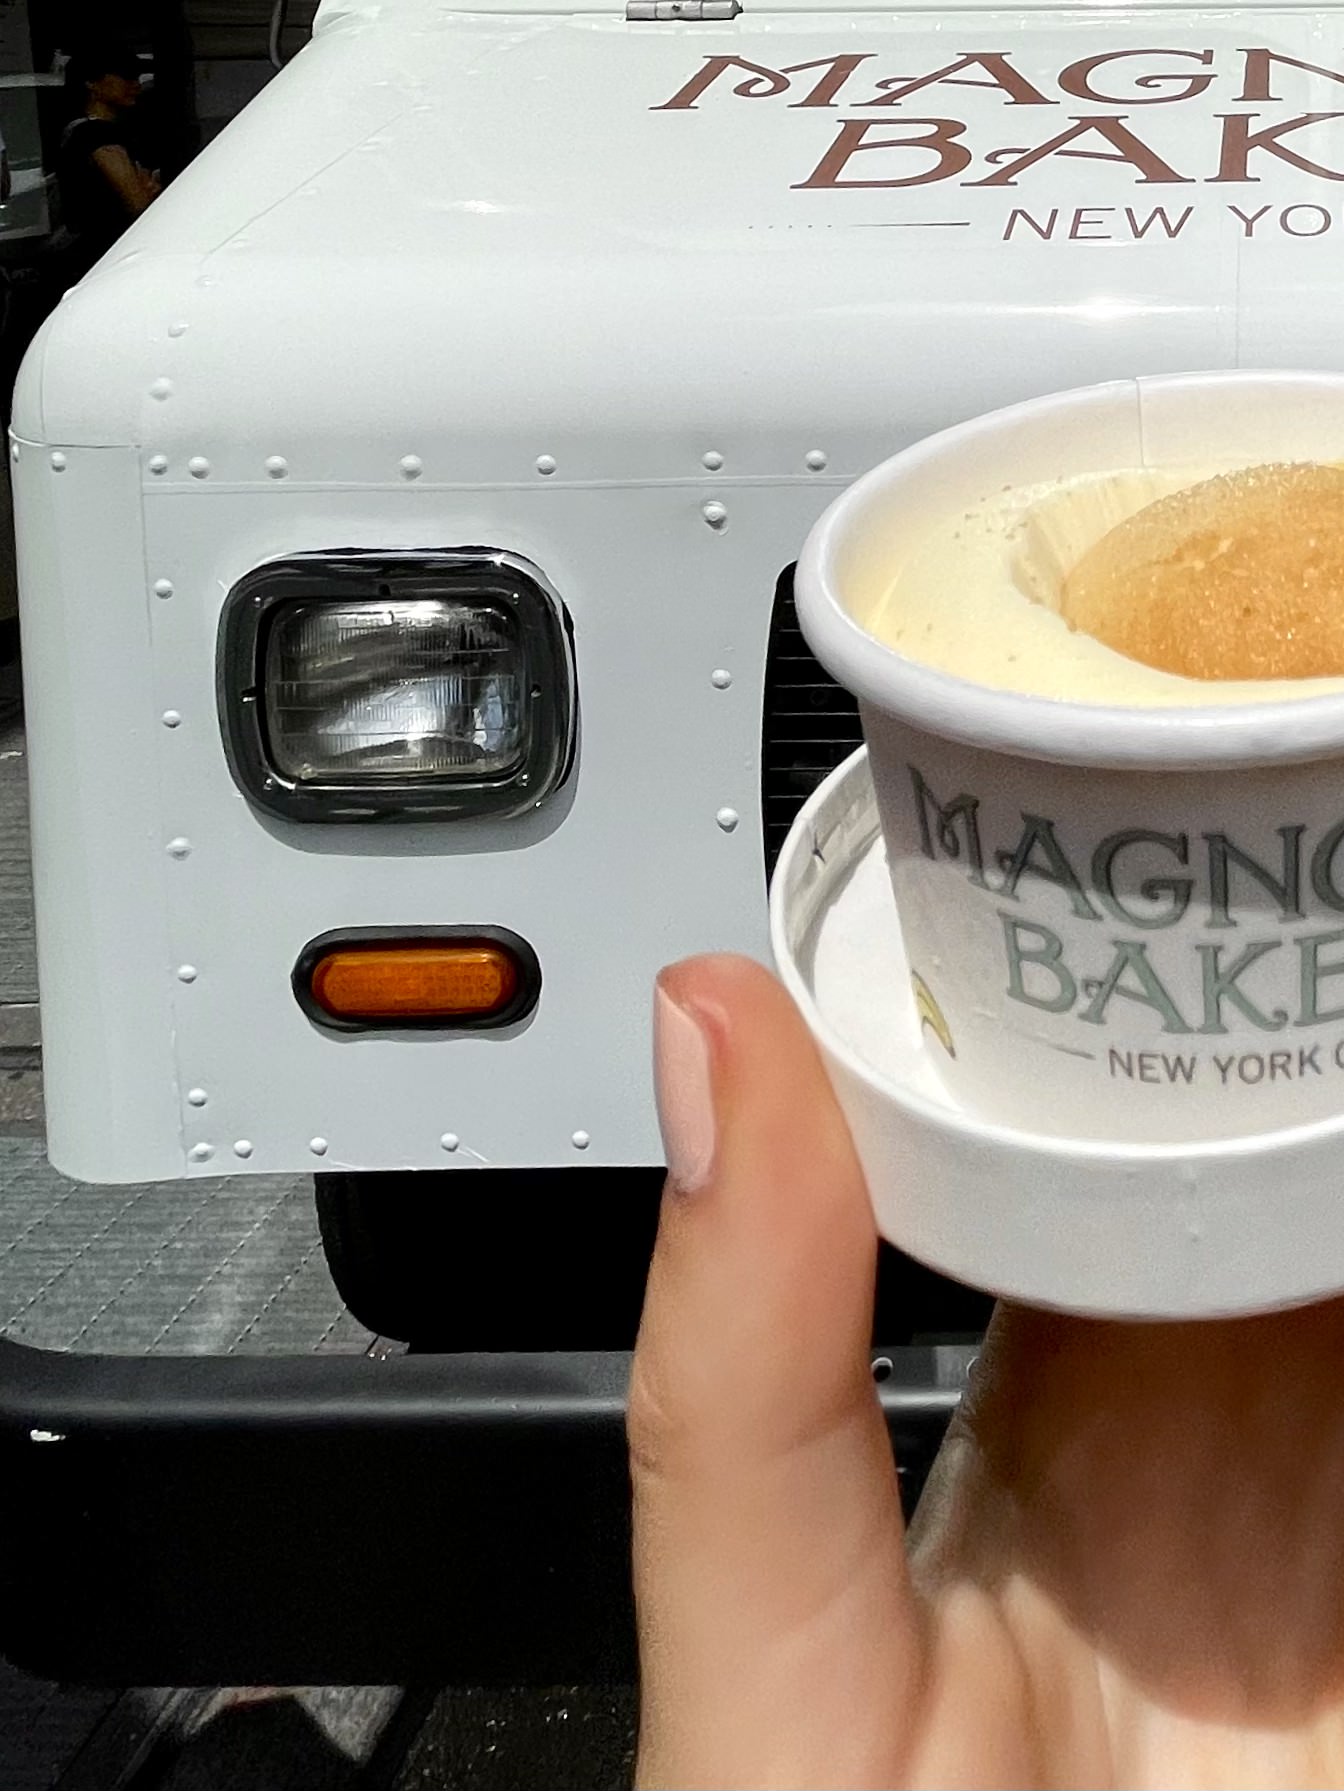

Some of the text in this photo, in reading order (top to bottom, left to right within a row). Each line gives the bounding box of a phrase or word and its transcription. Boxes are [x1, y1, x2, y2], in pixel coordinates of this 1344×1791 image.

[1002, 206, 1195, 242] NEW
[1108, 1047, 1197, 1085] NEW
[1212, 1042, 1324, 1085] YORK
